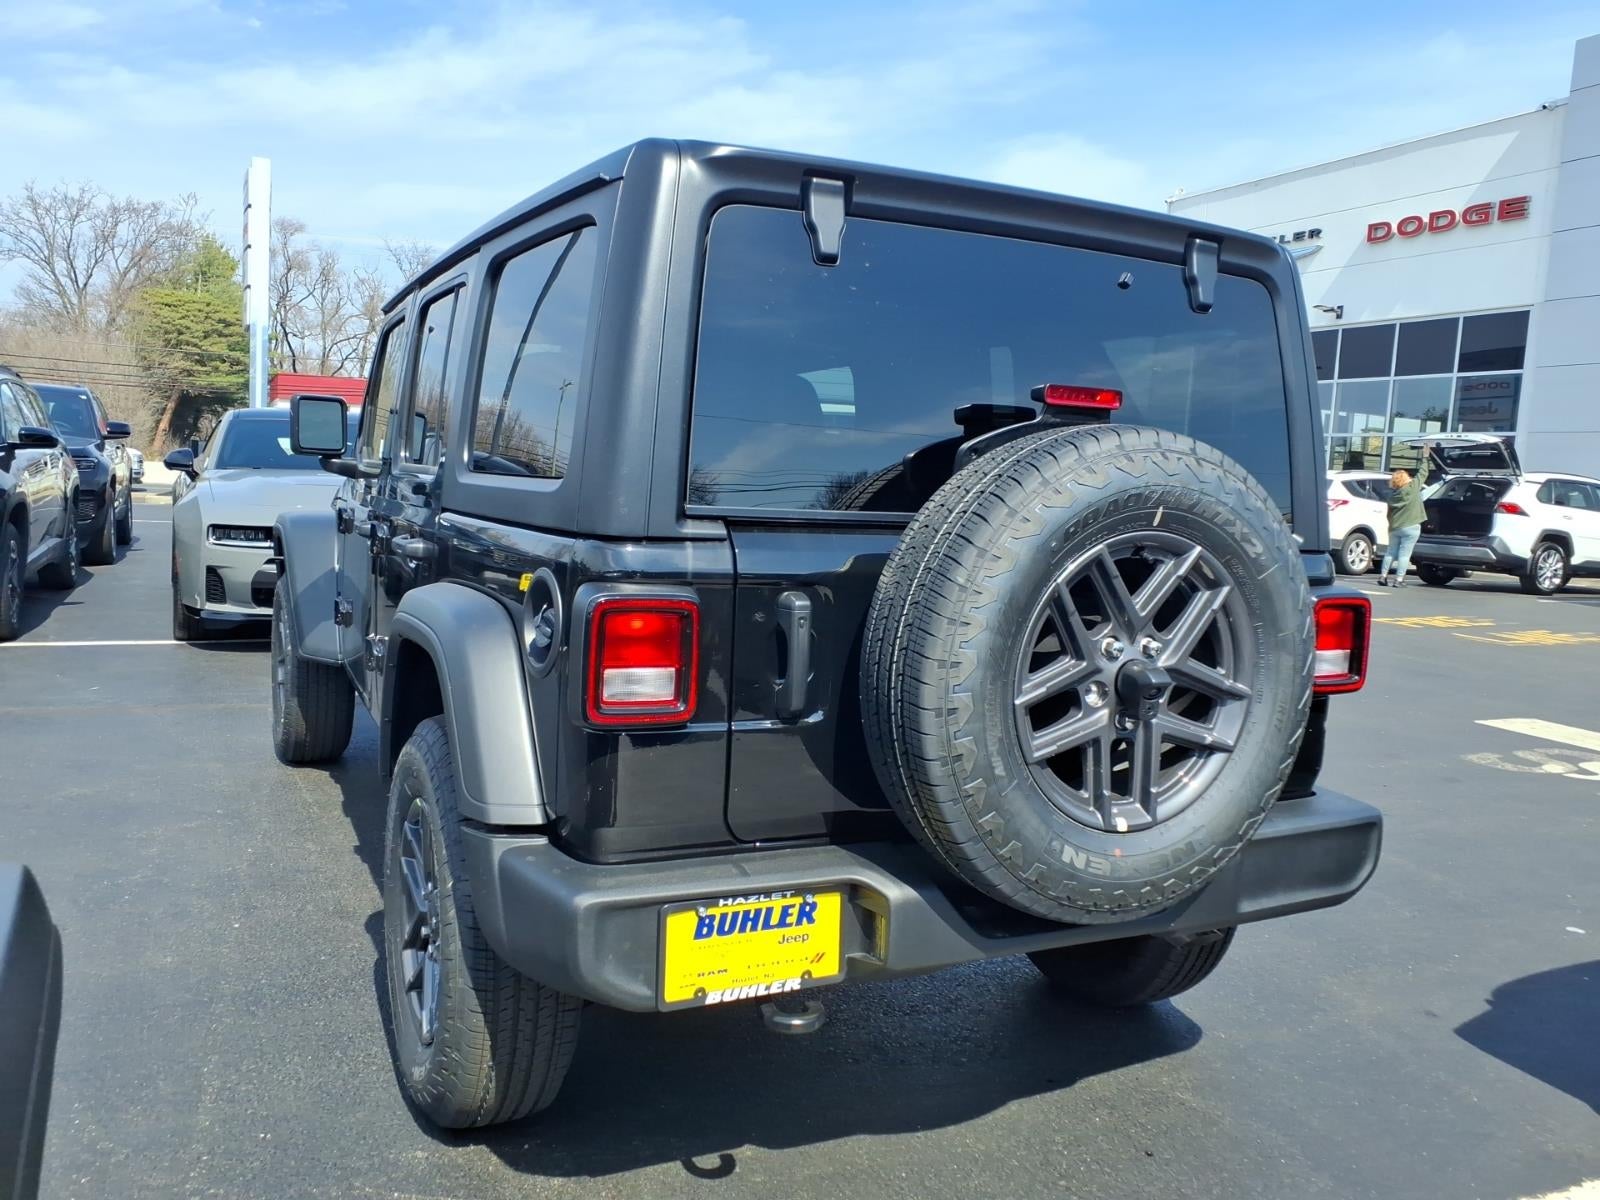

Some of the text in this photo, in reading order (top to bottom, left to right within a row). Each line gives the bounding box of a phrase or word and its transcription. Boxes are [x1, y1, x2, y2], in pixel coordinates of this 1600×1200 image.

[1367, 195, 1531, 244] DODGE
[718, 890, 796, 907] HAZLET
[693, 900, 818, 940] BUHLER
[778, 932, 810, 945] Jeep
[704, 977, 802, 1005] BUHLER
